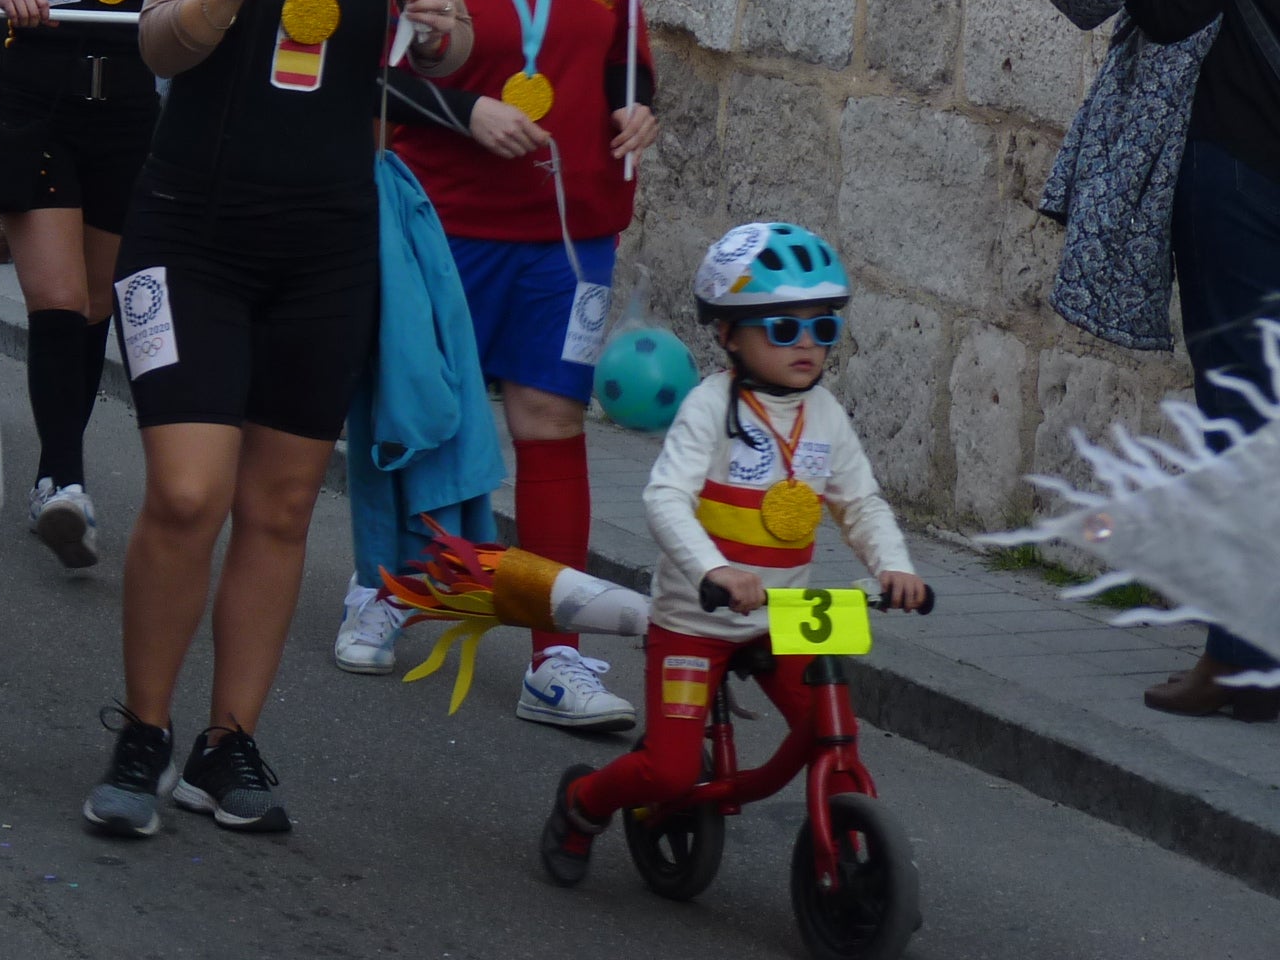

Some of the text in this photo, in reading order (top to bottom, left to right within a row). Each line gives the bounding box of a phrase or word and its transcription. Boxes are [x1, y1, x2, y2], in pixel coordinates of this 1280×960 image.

[126, 322, 170, 345] TOKYO 2020
[799, 589, 832, 644] 3
